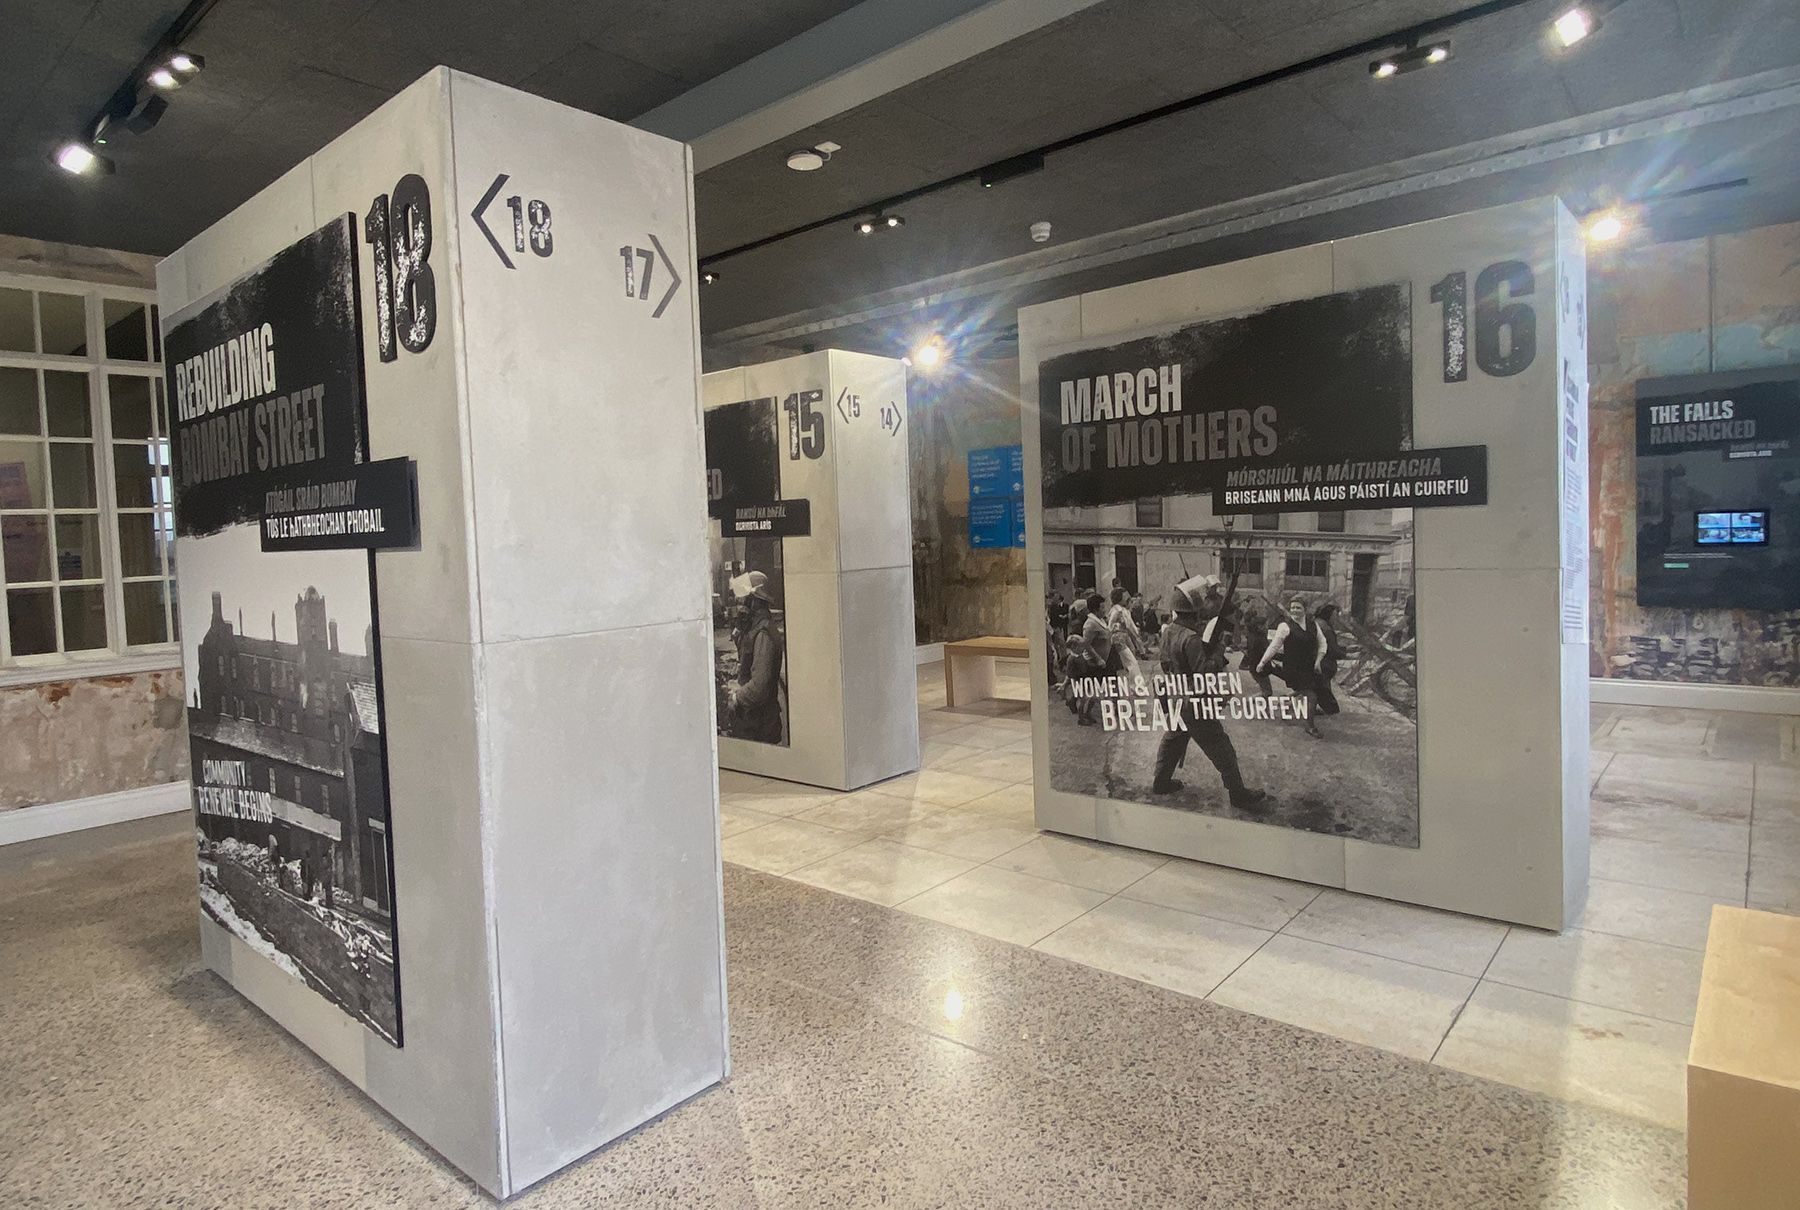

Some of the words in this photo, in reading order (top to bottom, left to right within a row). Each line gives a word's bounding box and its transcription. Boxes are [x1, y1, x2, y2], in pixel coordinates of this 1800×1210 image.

[507, 195, 553, 258] 18
[365, 173, 437, 363] 18
[619, 246, 654, 300] 17
[1430, 260, 1537, 383] 16
[175, 322, 277, 422] REBUILDING
[846, 394, 861, 418] 15
[1060, 363, 1182, 425] MARCH
[783, 388, 825, 460] 15
[880, 407, 893, 430] 14
[1650, 404, 1680, 424] THE
[1684, 400, 1734, 422] FALLS
[180, 407, 250, 486] BOMBAY
[254, 383, 326, 471] STREET
[1061, 426, 1096, 474] OF
[1107, 405, 1278, 469] MOTHERS
[1650, 419, 1756, 445] RANSACKED
[1226, 462, 1298, 487] MÓRSHIÚL
[1302, 465, 1322, 483] NA
[1326, 456, 1442, 482] MÁITHREACHA
[296, 479, 320, 511] SRÁID
[321, 479, 357, 508] BOMBAY
[1225, 487, 1281, 505] BRISEANN
[1284, 484, 1311, 502] MNÁ
[1313, 484, 1346, 501] AGUS
[1349, 480, 1390, 499] PÁISTÍ
[1392, 482, 1411, 497] AN
[1414, 475, 1469, 496] CUIRFIÚ
[266, 514, 280, 539] TÚS
[280, 517, 289, 538] LE
[347, 508, 385, 534] PHOBAIL
[1071, 676, 1130, 698] WOMEN
[1134, 674, 1150, 696] &
[1153, 671, 1243, 697] CHILDREN
[1100, 698, 1188, 731] BREAK
[1189, 697, 1226, 720] THE
[1229, 696, 1309, 720] CURFEW
[202, 759, 246, 787] COMMUNITY
[198, 785, 239, 819] RENEWAL
[238, 788, 273, 824] BEGINS
